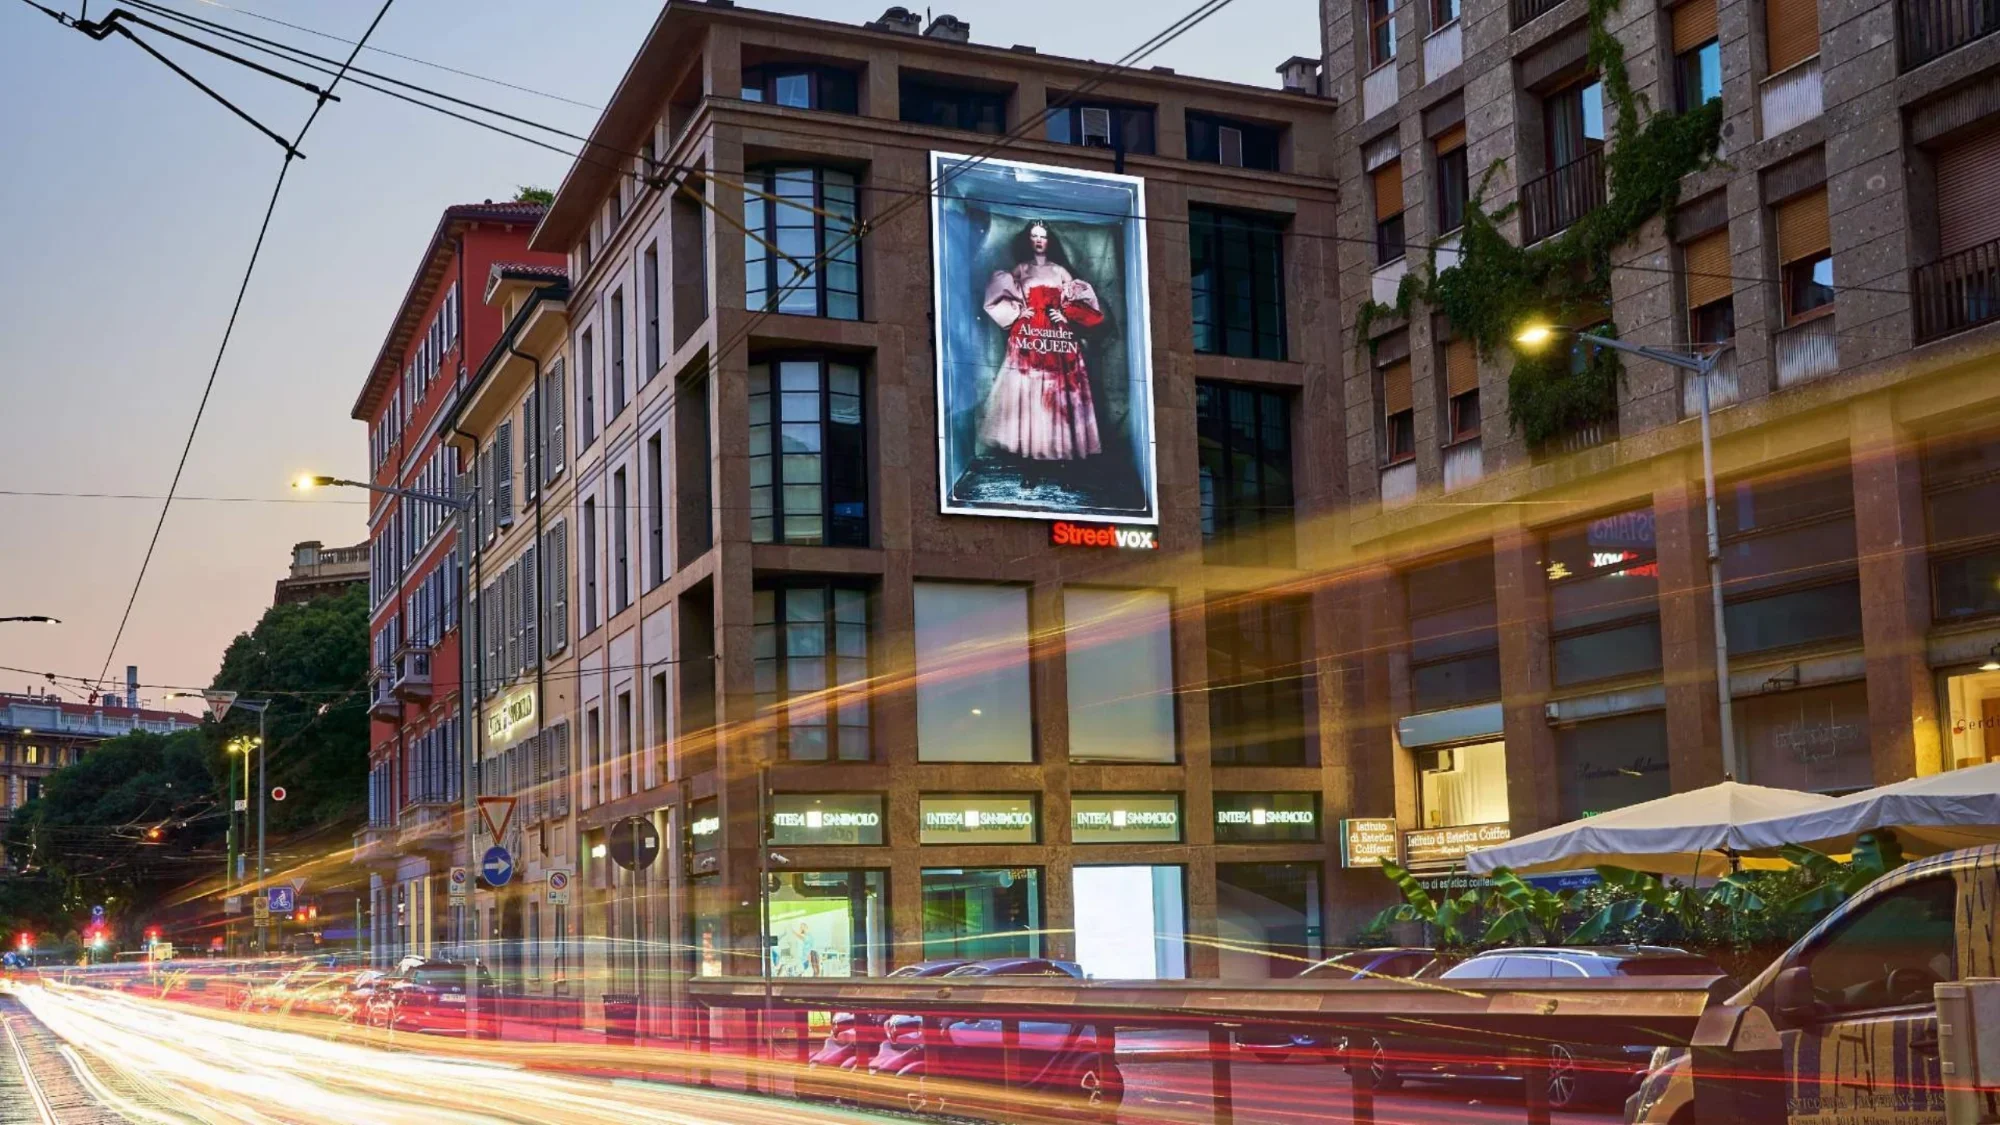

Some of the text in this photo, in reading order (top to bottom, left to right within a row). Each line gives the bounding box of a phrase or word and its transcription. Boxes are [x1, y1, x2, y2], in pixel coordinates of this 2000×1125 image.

[1018, 324, 1073, 339] Alexander
[1015, 337, 1078, 354] McQUEEN
[926, 812, 964, 825] INTESA
[1076, 812, 1112, 825] INTESA
[1218, 811, 1251, 823] INTESA
[1408, 835, 1435, 847] Istituto
[1437, 832, 1445, 845] di
[1446, 829, 1478, 844] Estetica
